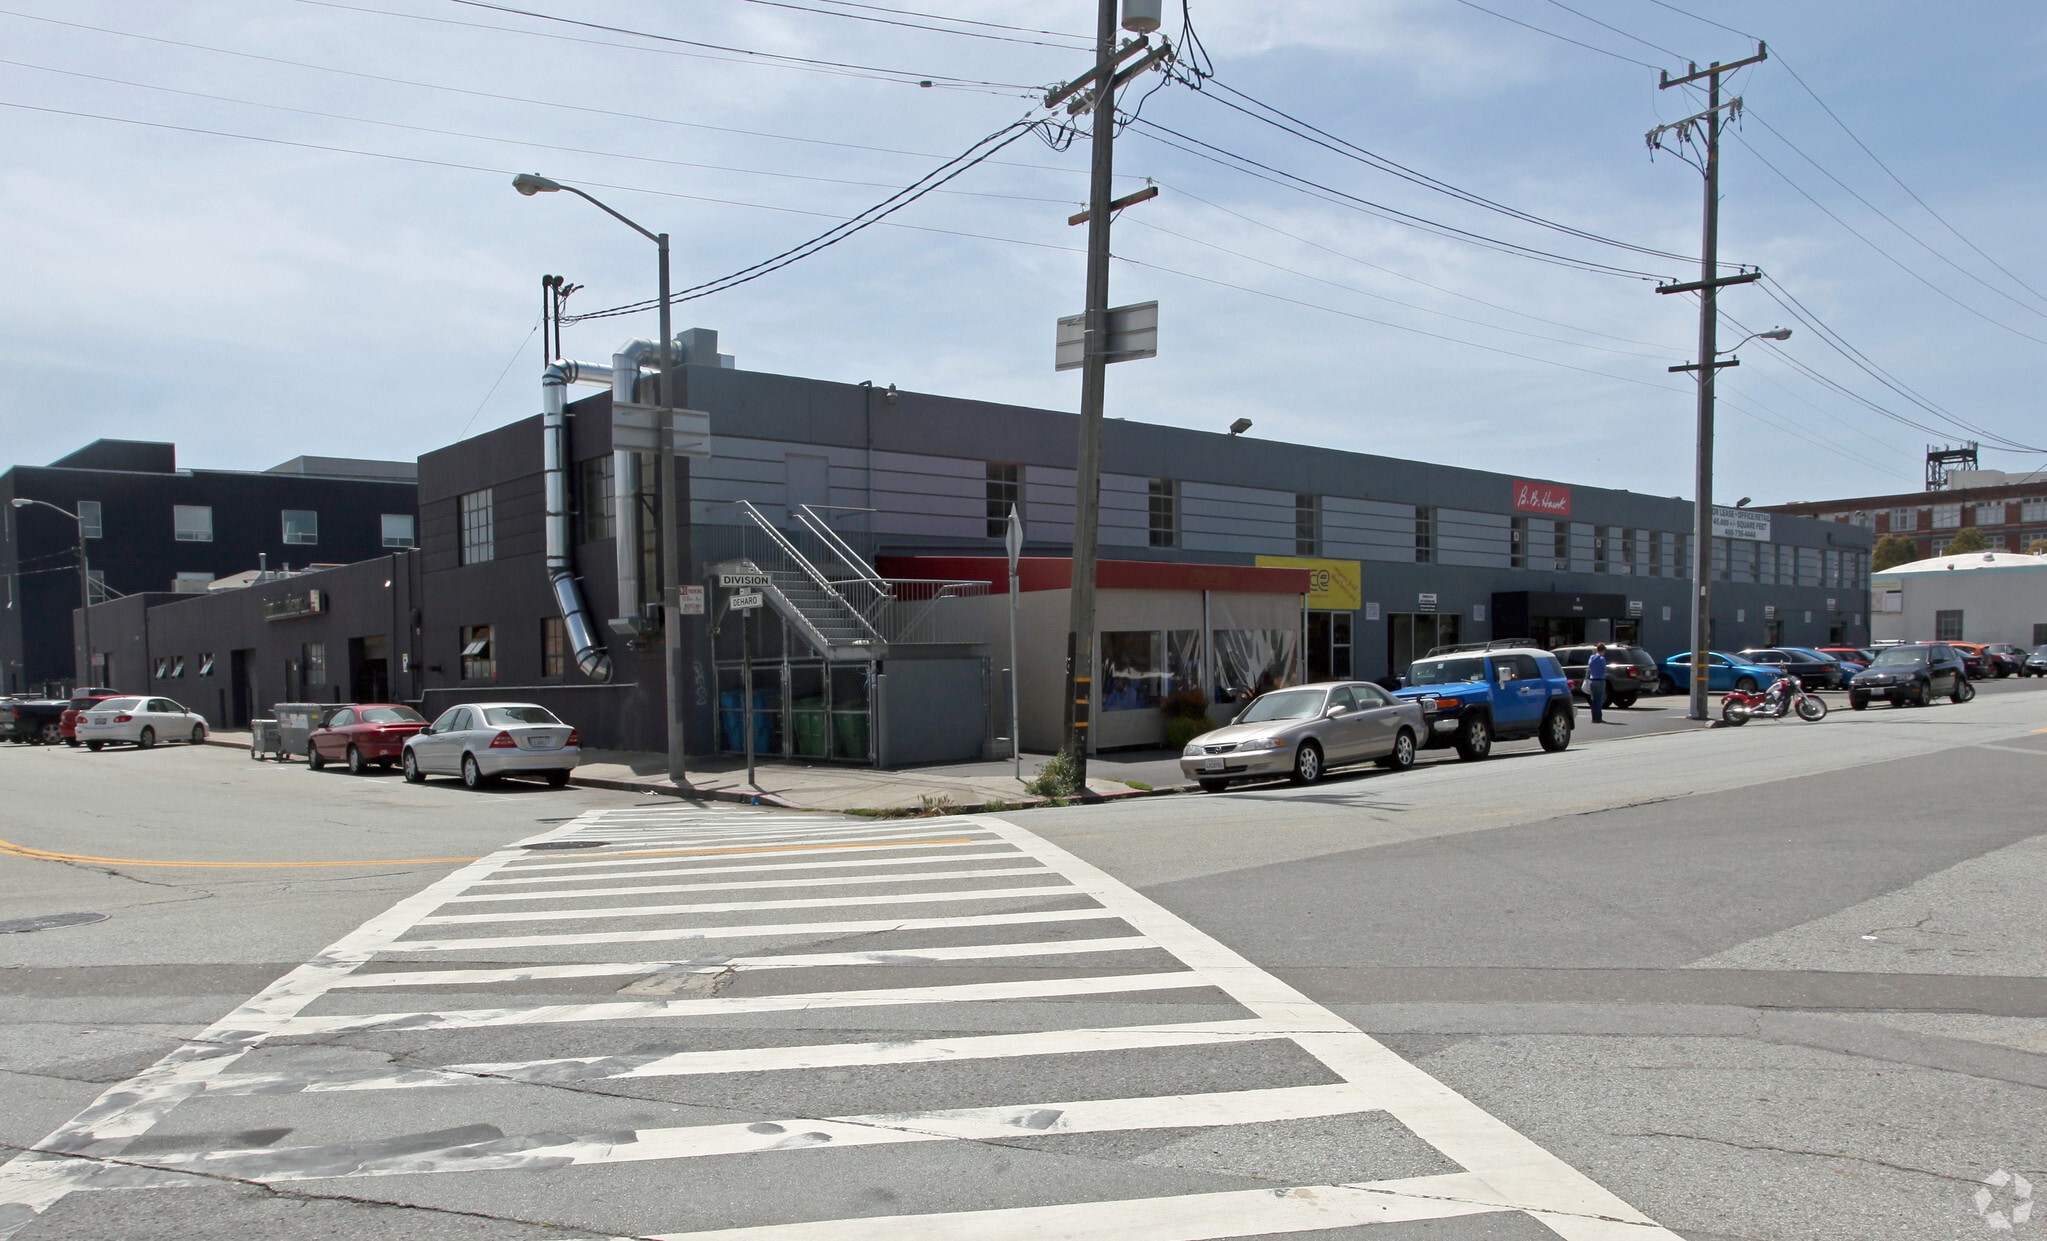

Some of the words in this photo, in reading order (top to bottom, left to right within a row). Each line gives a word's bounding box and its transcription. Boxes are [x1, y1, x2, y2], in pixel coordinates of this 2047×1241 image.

[1720, 508, 1735, 518] LEASE
[1737, 520, 1756, 530] SQUARE
[1756, 523, 1767, 531] FEET
[724, 576, 769, 585] DIVISION
[1310, 568, 1330, 592] ce
[733, 596, 758, 607] DEHARO
